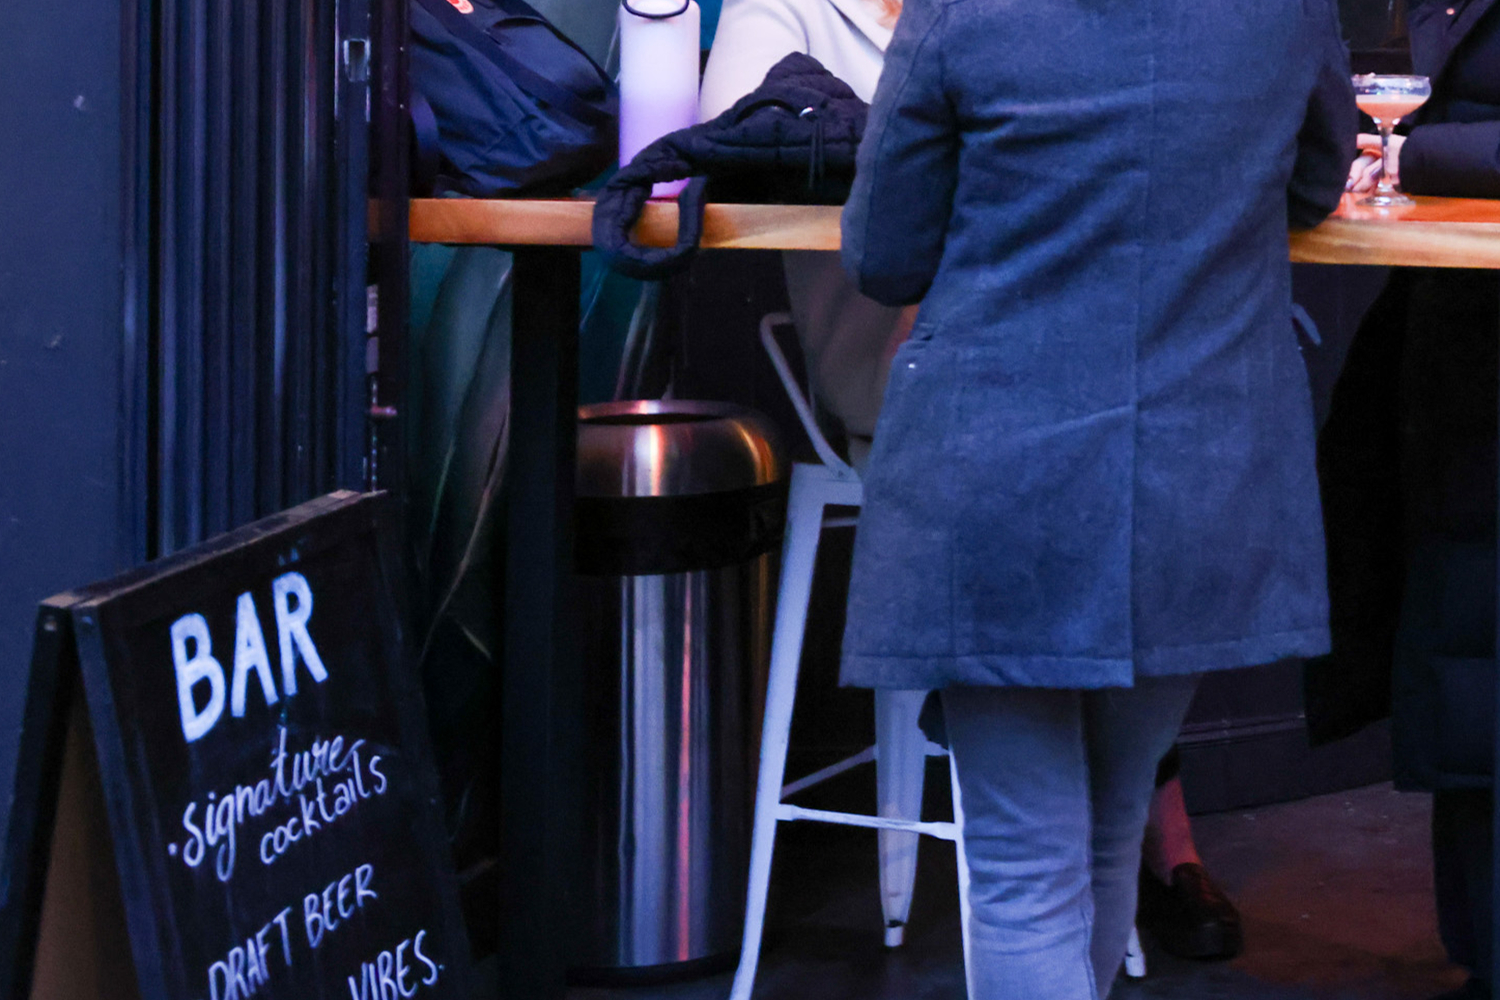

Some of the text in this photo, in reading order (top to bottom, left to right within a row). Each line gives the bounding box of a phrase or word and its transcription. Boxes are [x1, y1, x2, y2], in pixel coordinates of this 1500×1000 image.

[170, 570, 328, 744] BAR
[260, 750, 388, 865] cocktails
[208, 863, 378, 1000] DRAFT BEER
